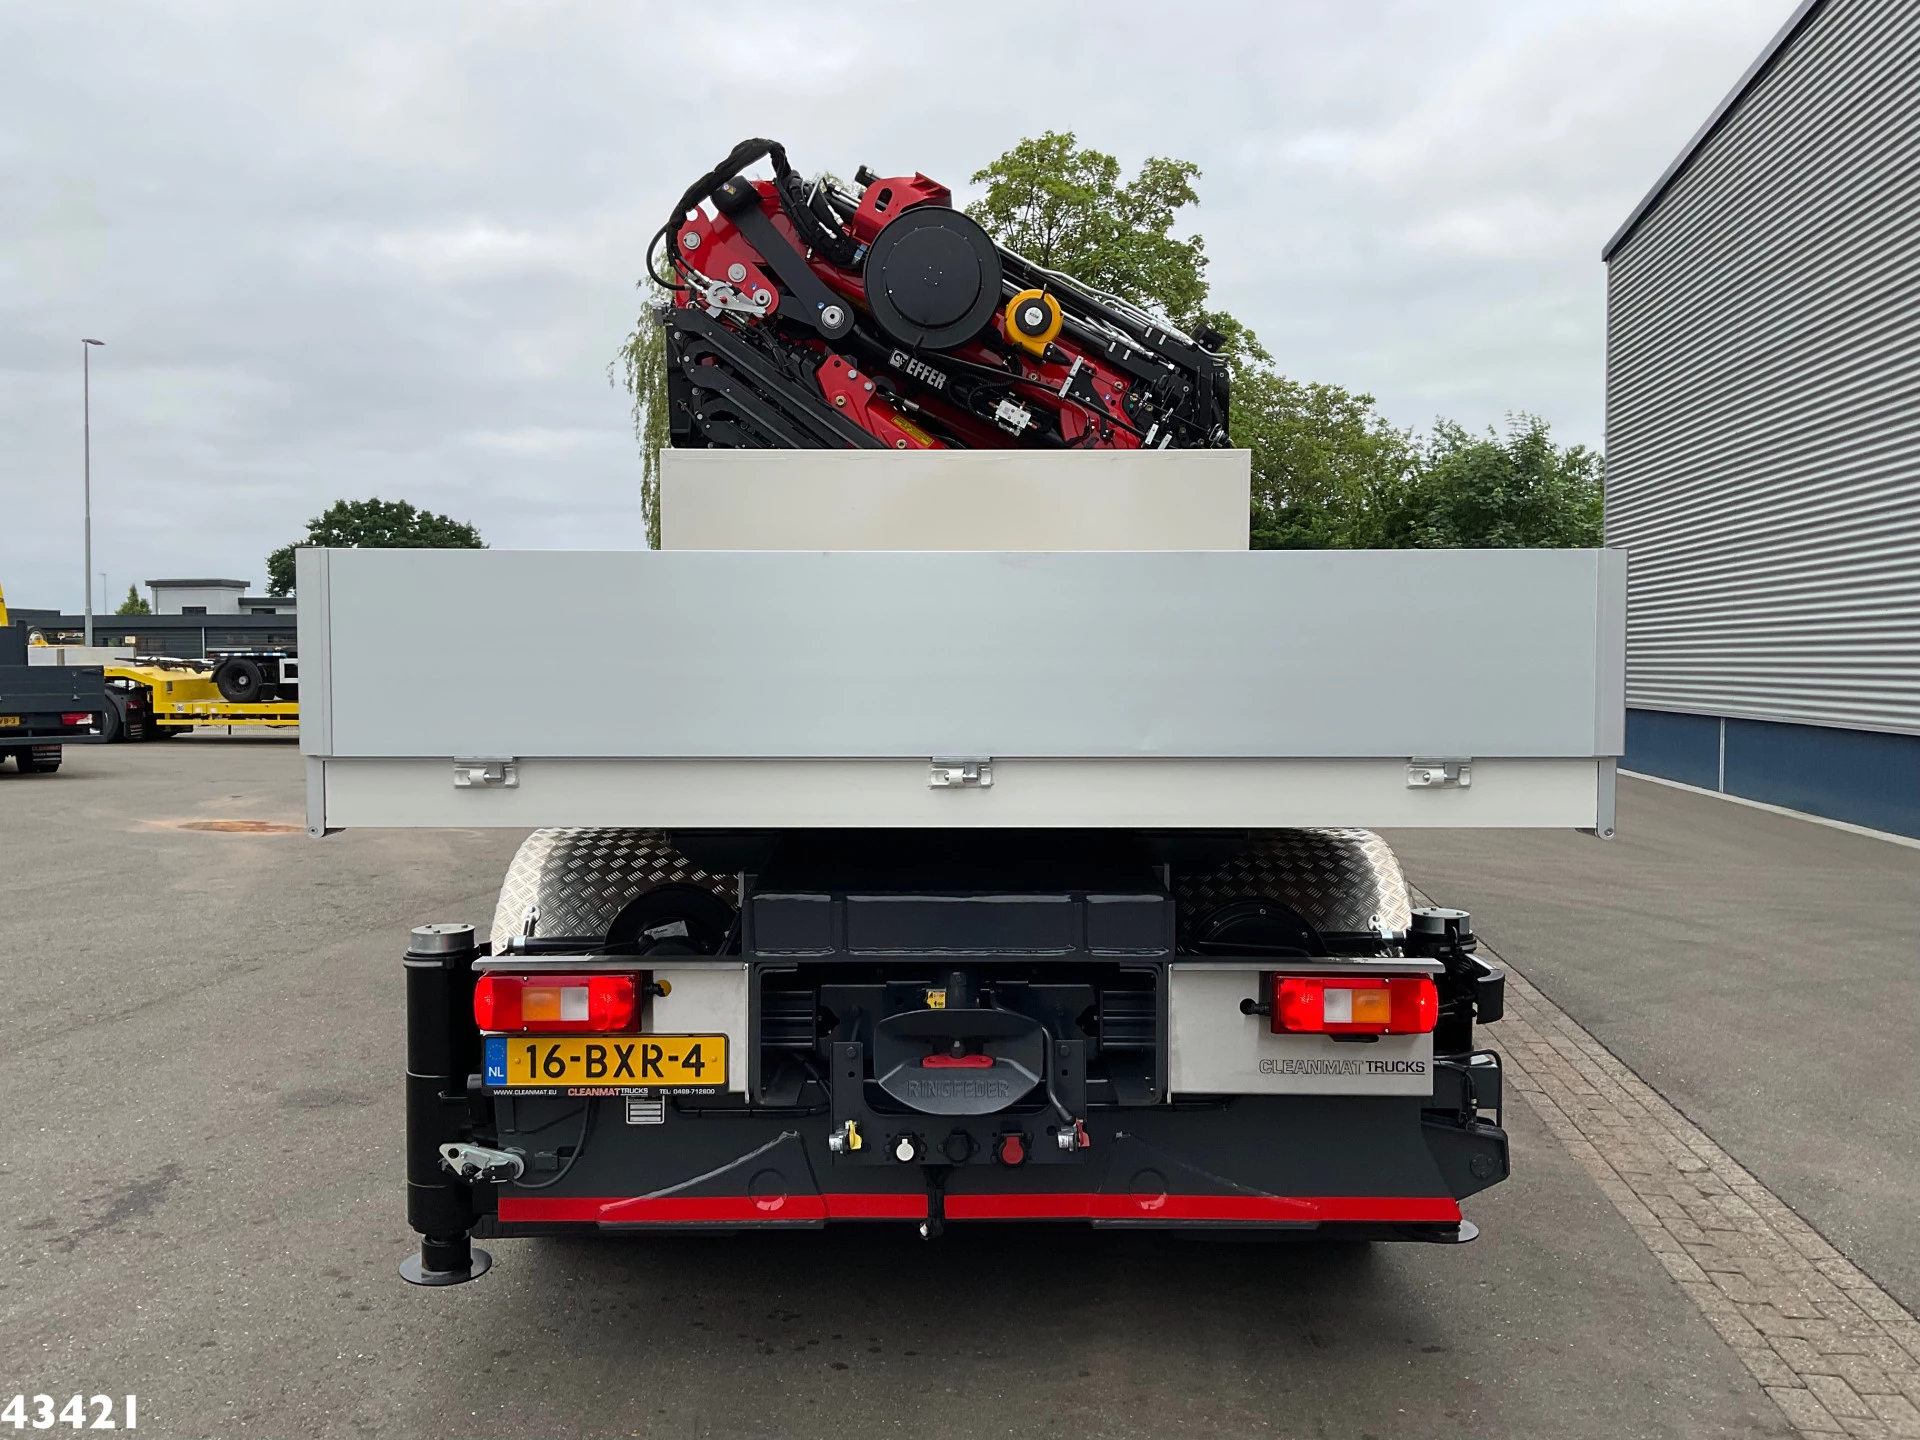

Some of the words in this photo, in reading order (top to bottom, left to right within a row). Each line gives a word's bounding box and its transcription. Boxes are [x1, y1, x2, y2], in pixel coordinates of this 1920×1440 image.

[906, 358, 947, 390] EFFER
[526, 1043, 706, 1079] 16-BXR-4
[1259, 1059, 1363, 1075] CLEANMAT
[1365, 1060, 1425, 1073] TRUCKS
[488, 1066, 504, 1077] NL
[493, 1088, 557, 1096] WWW.CLEANMAT.EU
[567, 1087, 620, 1097] CLEANMAT
[620, 1087, 648, 1095] TRUCKS
[907, 1080, 1010, 1098] RINGFEDER
